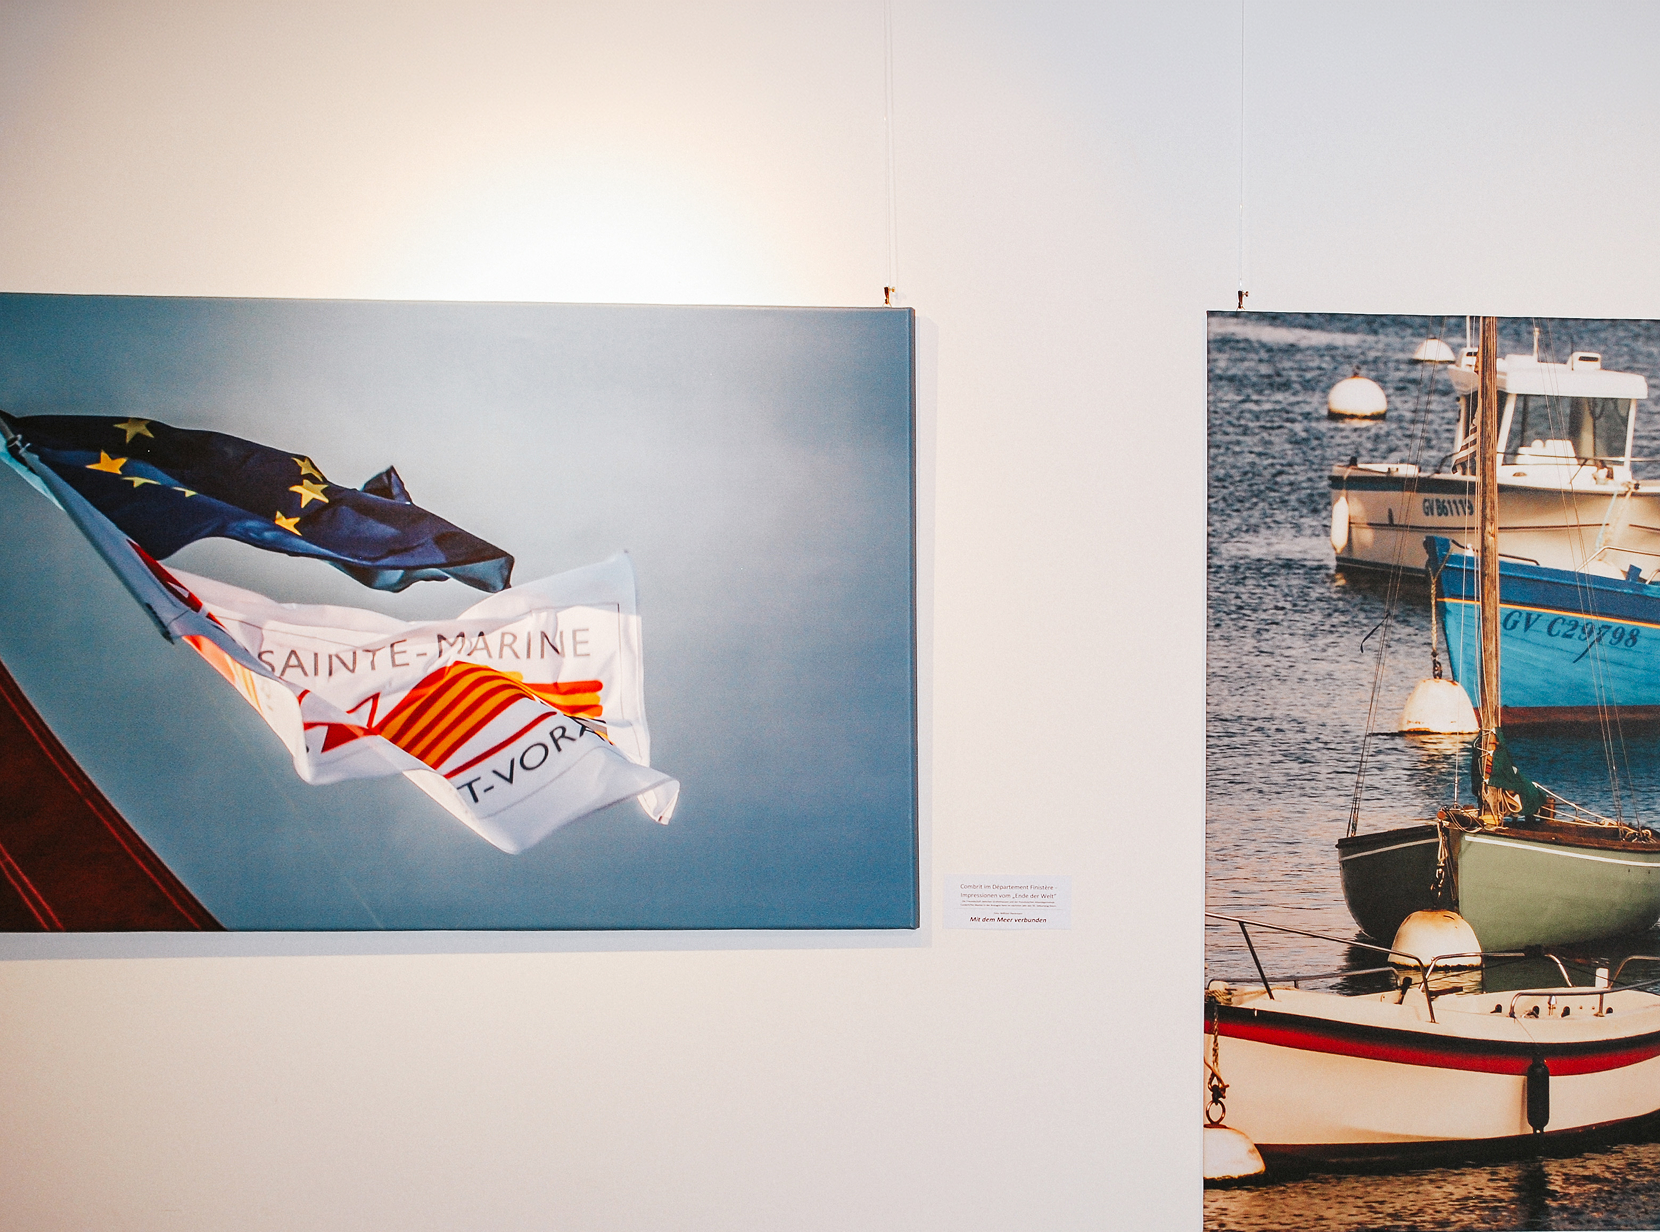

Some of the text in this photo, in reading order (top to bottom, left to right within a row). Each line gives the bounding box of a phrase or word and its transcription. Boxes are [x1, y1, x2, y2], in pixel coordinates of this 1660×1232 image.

[1422, 498, 1434, 516] GV
[1502, 610, 1640, 649] GV C29798
[257, 628, 591, 678] SAINTE-MARINE
